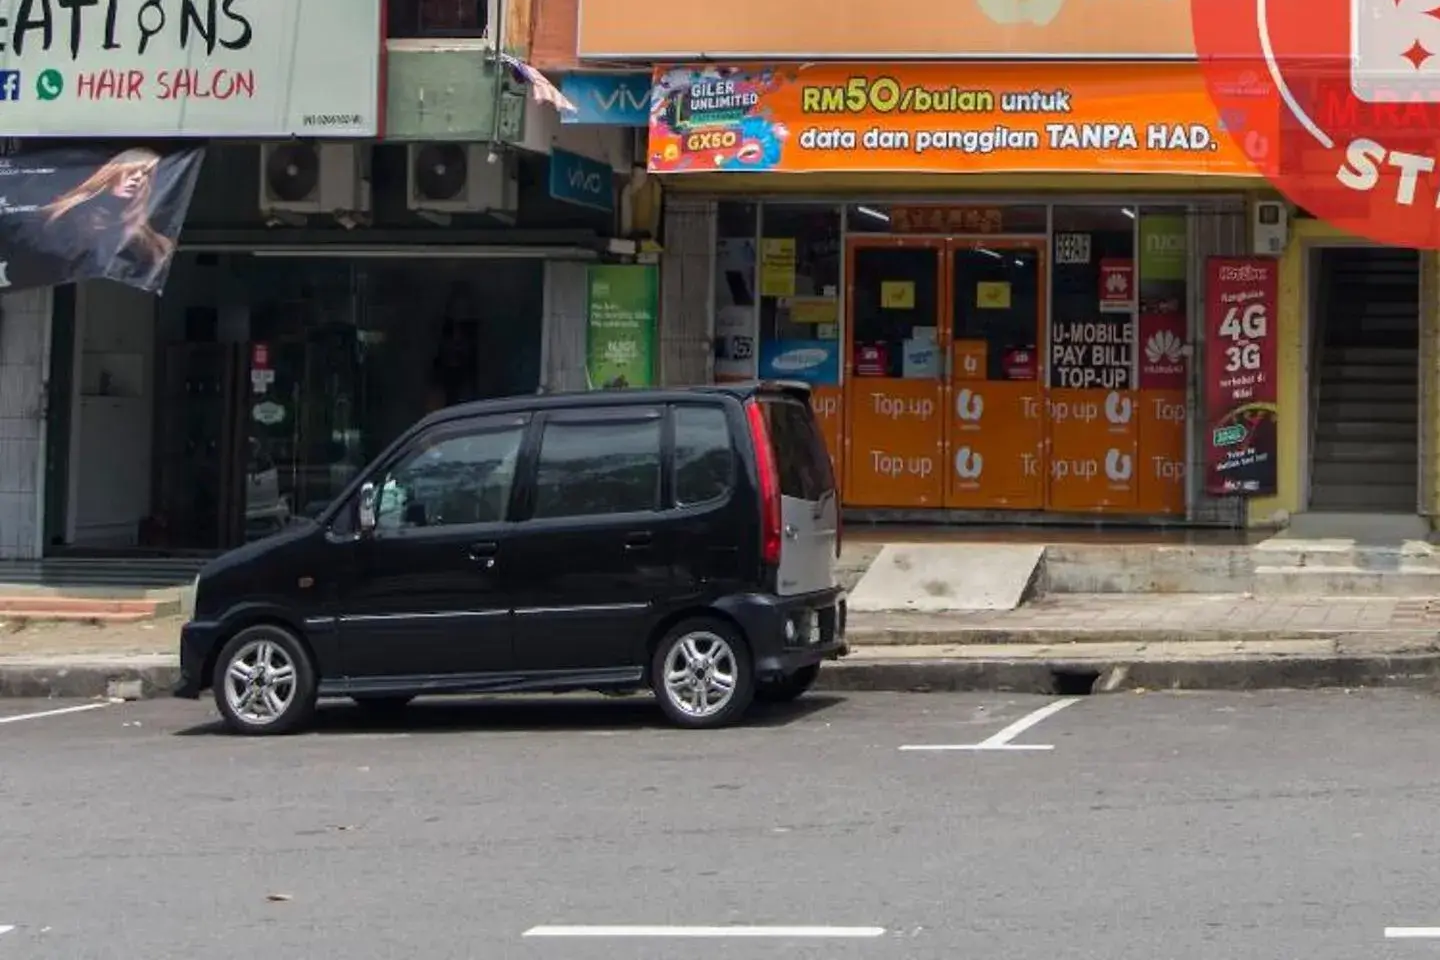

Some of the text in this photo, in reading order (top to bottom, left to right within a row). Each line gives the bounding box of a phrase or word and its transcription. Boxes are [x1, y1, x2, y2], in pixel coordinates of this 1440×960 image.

[77, 67, 255, 100] HAIR SALON
[593, 83, 650, 111] viv
[802, 76, 1072, 114] RM50/bulan untuk
[690, 92, 758, 110] UNLIMITED
[799, 124, 1218, 153] data dan panggilan TANPA HAD.
[1052, 322, 1133, 343] U-MOBILE
[1218, 304, 1267, 340] 4G
[1053, 344, 1088, 366] PAY
[1091, 344, 1132, 366] BILL
[1225, 343, 1261, 372] 3G
[1057, 366, 1128, 388] TOP-UP
[871, 393, 933, 420] Top up
[1072, 399, 1098, 422] up
[1153, 398, 1186, 424] Top
[870, 450, 933, 477] Top up
[1072, 457, 1098, 480] up
[1153, 455, 1186, 483] Top
